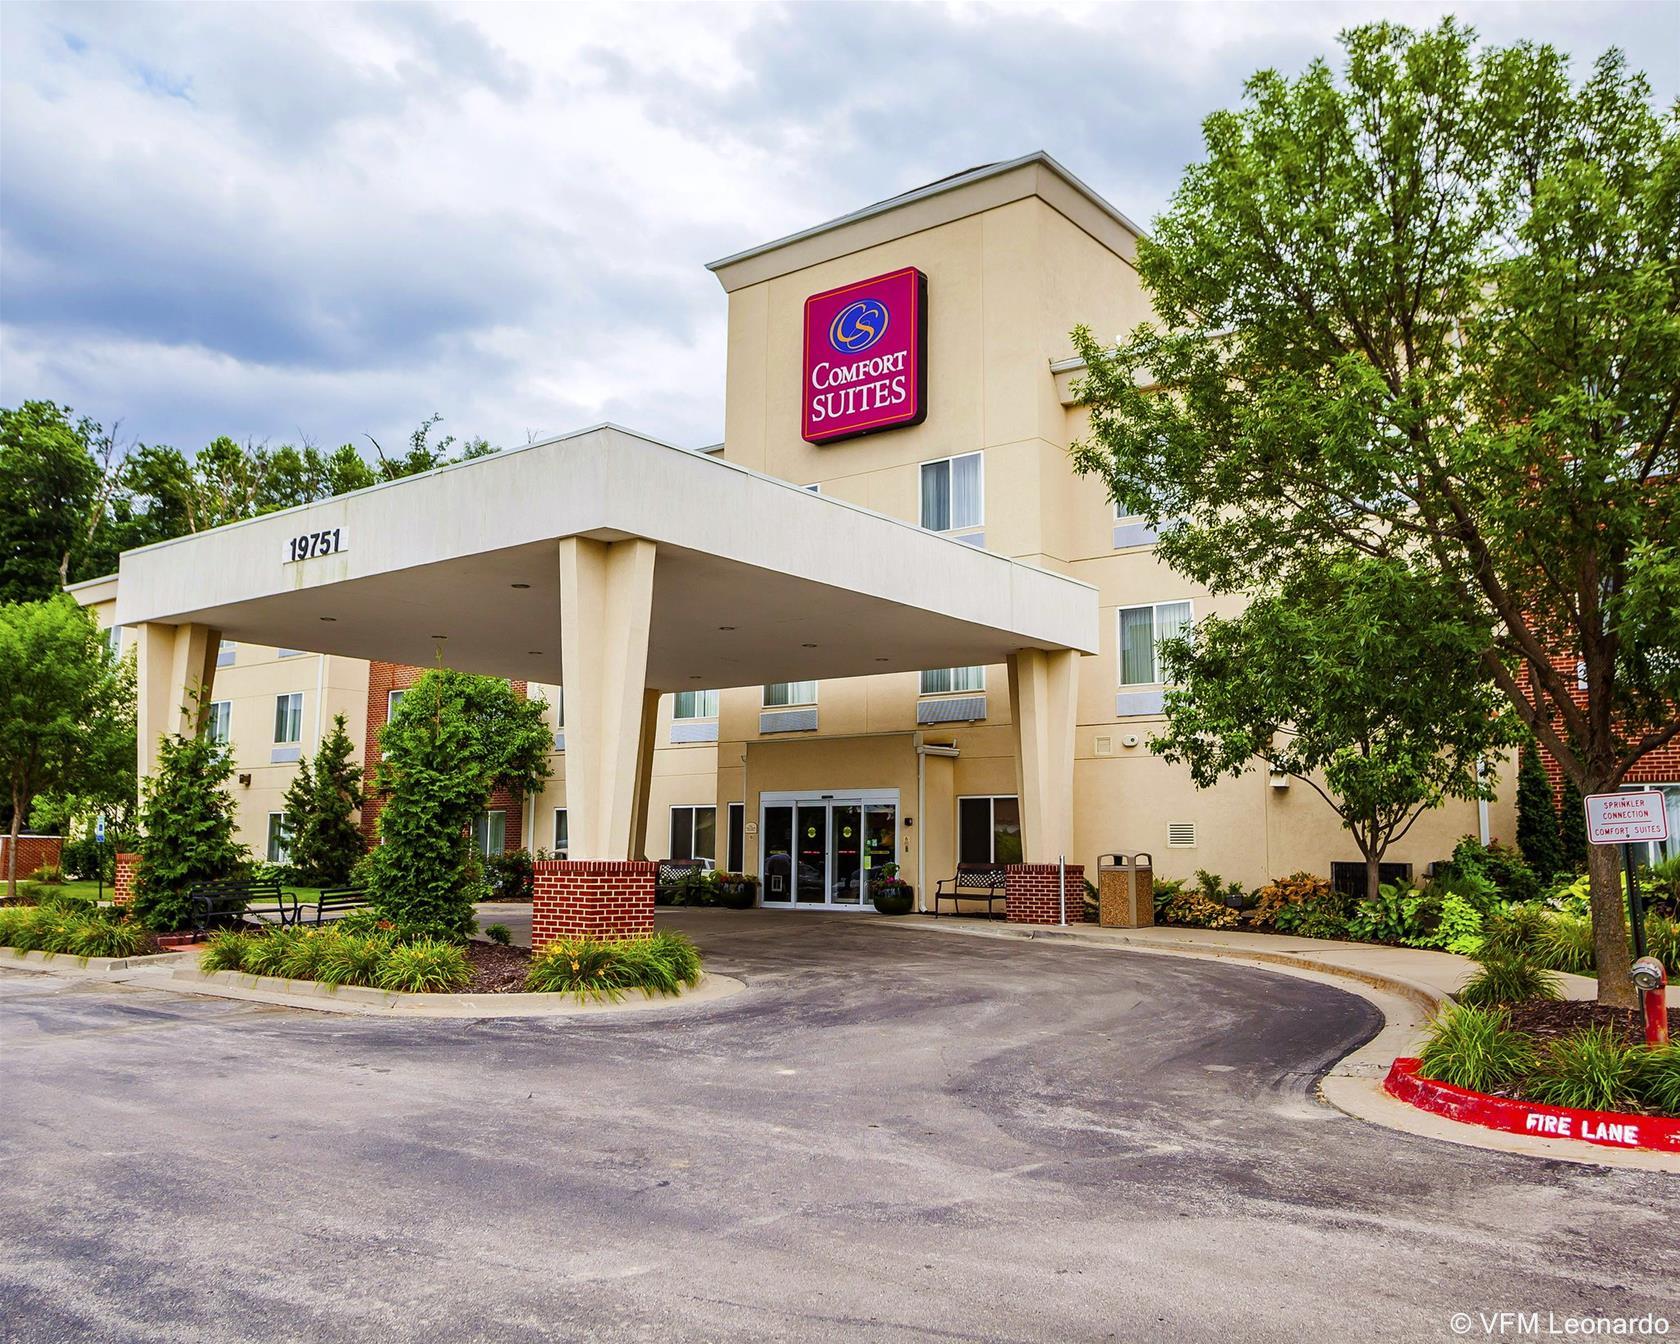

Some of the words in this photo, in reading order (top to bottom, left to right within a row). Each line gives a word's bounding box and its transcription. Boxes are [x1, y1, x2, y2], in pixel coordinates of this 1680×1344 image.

[811, 350, 907, 390] COMFORT
[811, 375, 907, 422] SUITES
[290, 528, 340, 561] 19751
[1602, 810, 1649, 820] CONNECTION
[1603, 799, 1645, 810] SPRINKLER
[1594, 827, 1629, 836] COMFORT
[1634, 825, 1661, 834] SUITES
[1526, 1113, 1572, 1137] FIRE
[1581, 1120, 1639, 1145] LANE
